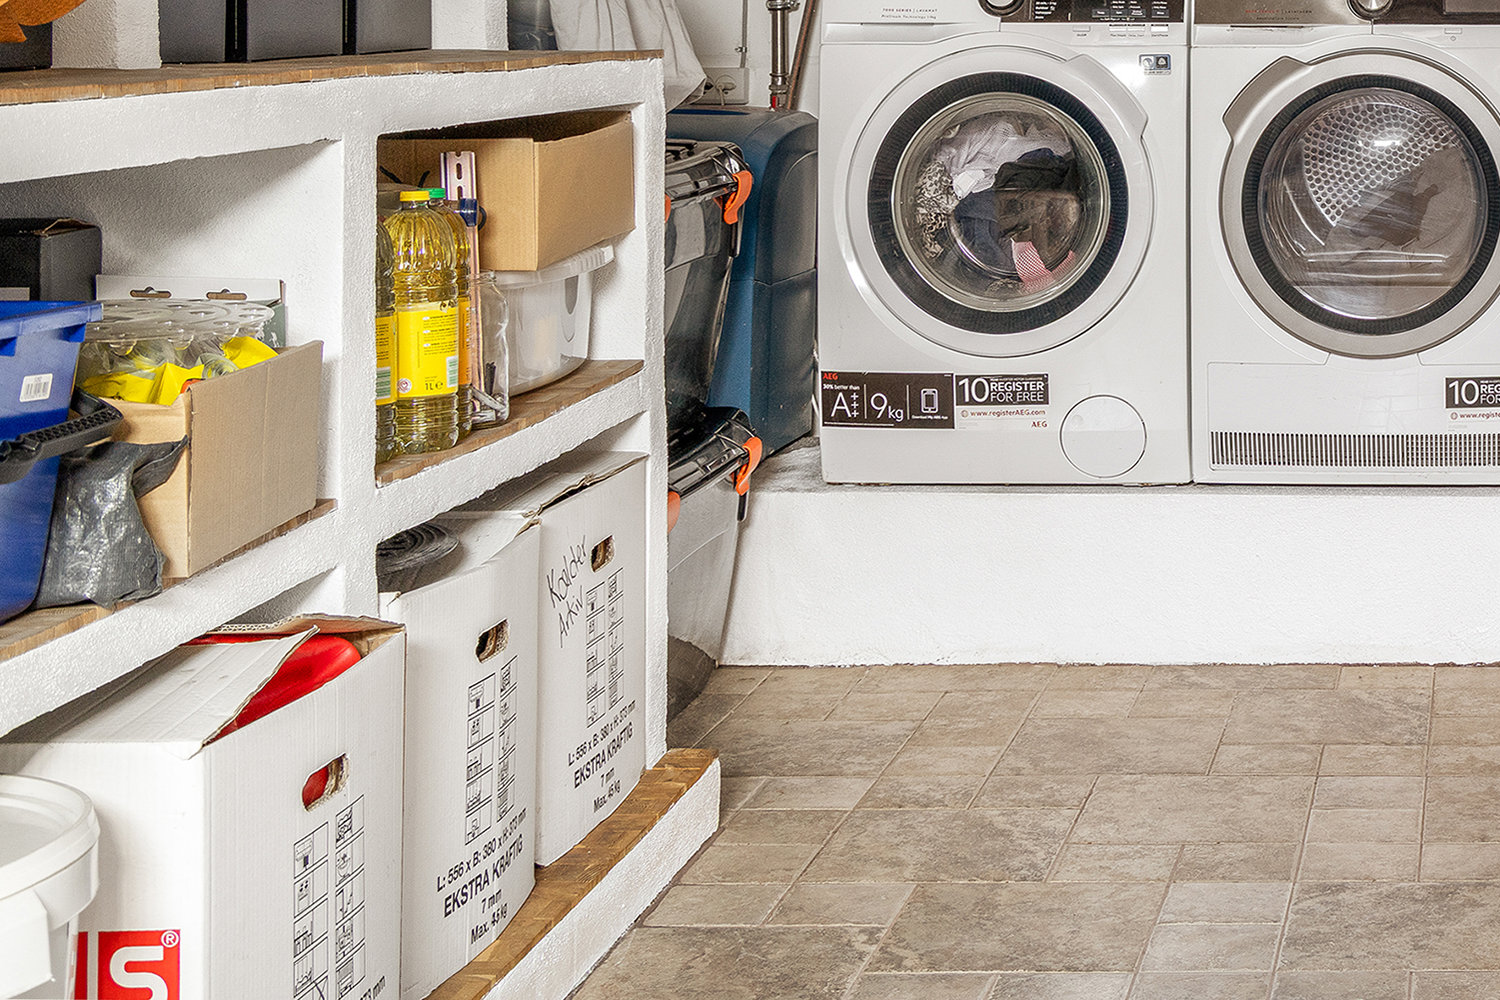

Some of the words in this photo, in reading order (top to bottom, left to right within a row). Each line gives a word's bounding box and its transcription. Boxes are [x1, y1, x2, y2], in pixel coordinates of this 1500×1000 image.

[822, 372, 839, 380] AEG
[990, 381, 1045, 392] REGISTER
[958, 377, 990, 402] 10
[990, 391, 1013, 402] FOR
[1016, 391, 1044, 402] FREE
[1448, 379, 1480, 405] 10
[970, 409, 1046, 418] www.registerAEG.com
[573, 749, 605, 789] EKSTRA
[606, 722, 633, 762] KRAFTIG
[436, 875, 446, 892] L:
[447, 861, 464, 884] 556
[465, 860, 471, 873] x
[473, 850, 482, 867] B:
[443, 868, 490, 918] EKSTRA
[491, 833, 524, 882] KRAFTIG
[481, 897, 486, 914] 7
[487, 888, 502, 910] mm
[470, 920, 490, 945] Max.
